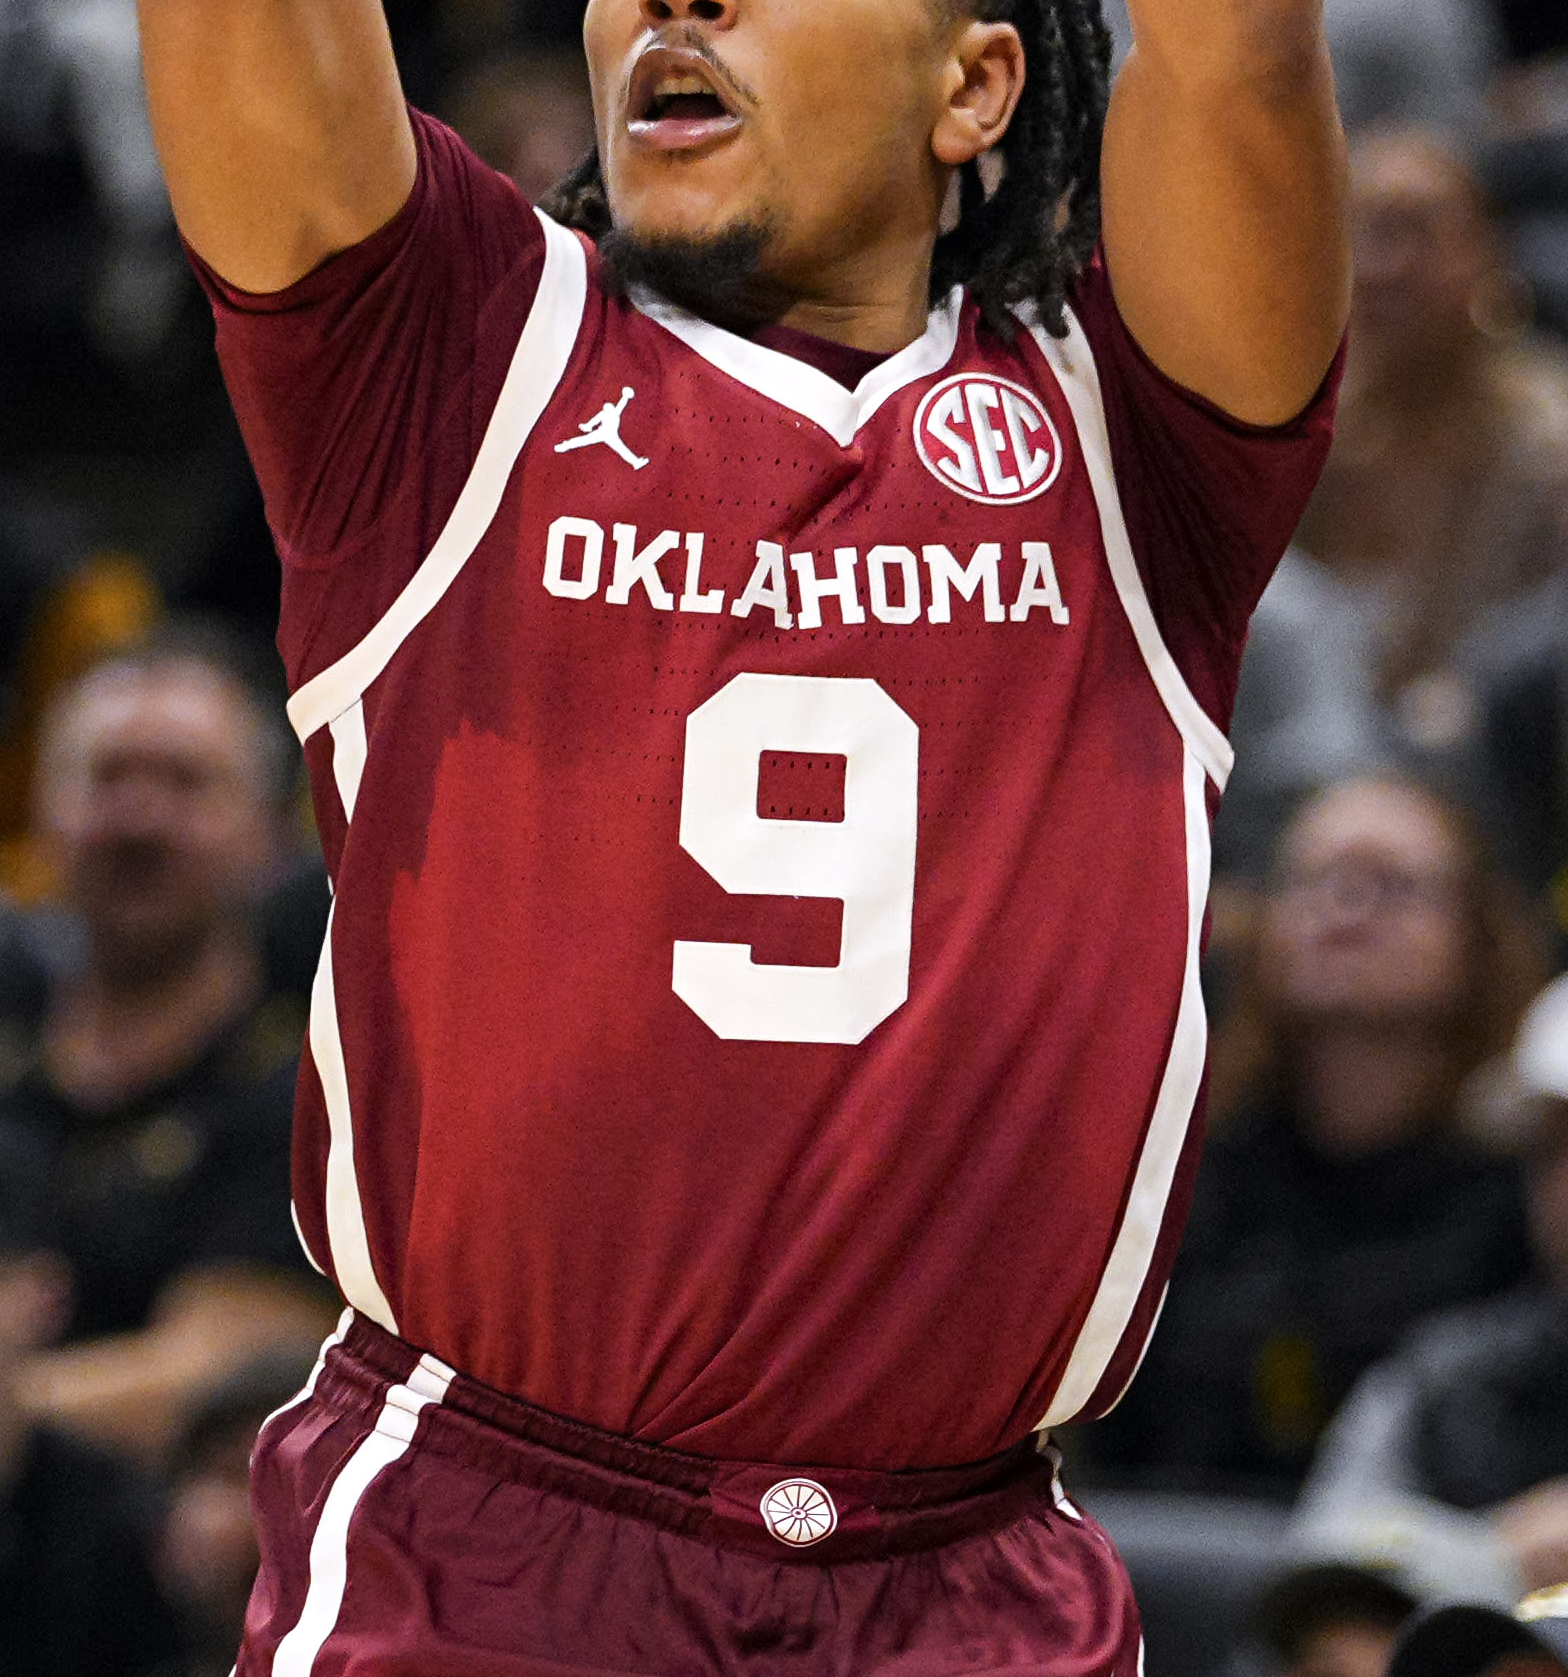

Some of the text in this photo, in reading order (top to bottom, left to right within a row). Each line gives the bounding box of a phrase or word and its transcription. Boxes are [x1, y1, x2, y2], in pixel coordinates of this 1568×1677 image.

[927, 383, 1050, 495] SEC
[542, 515, 1070, 630] OKLAHOMA
[672, 672, 920, 1045] 9
